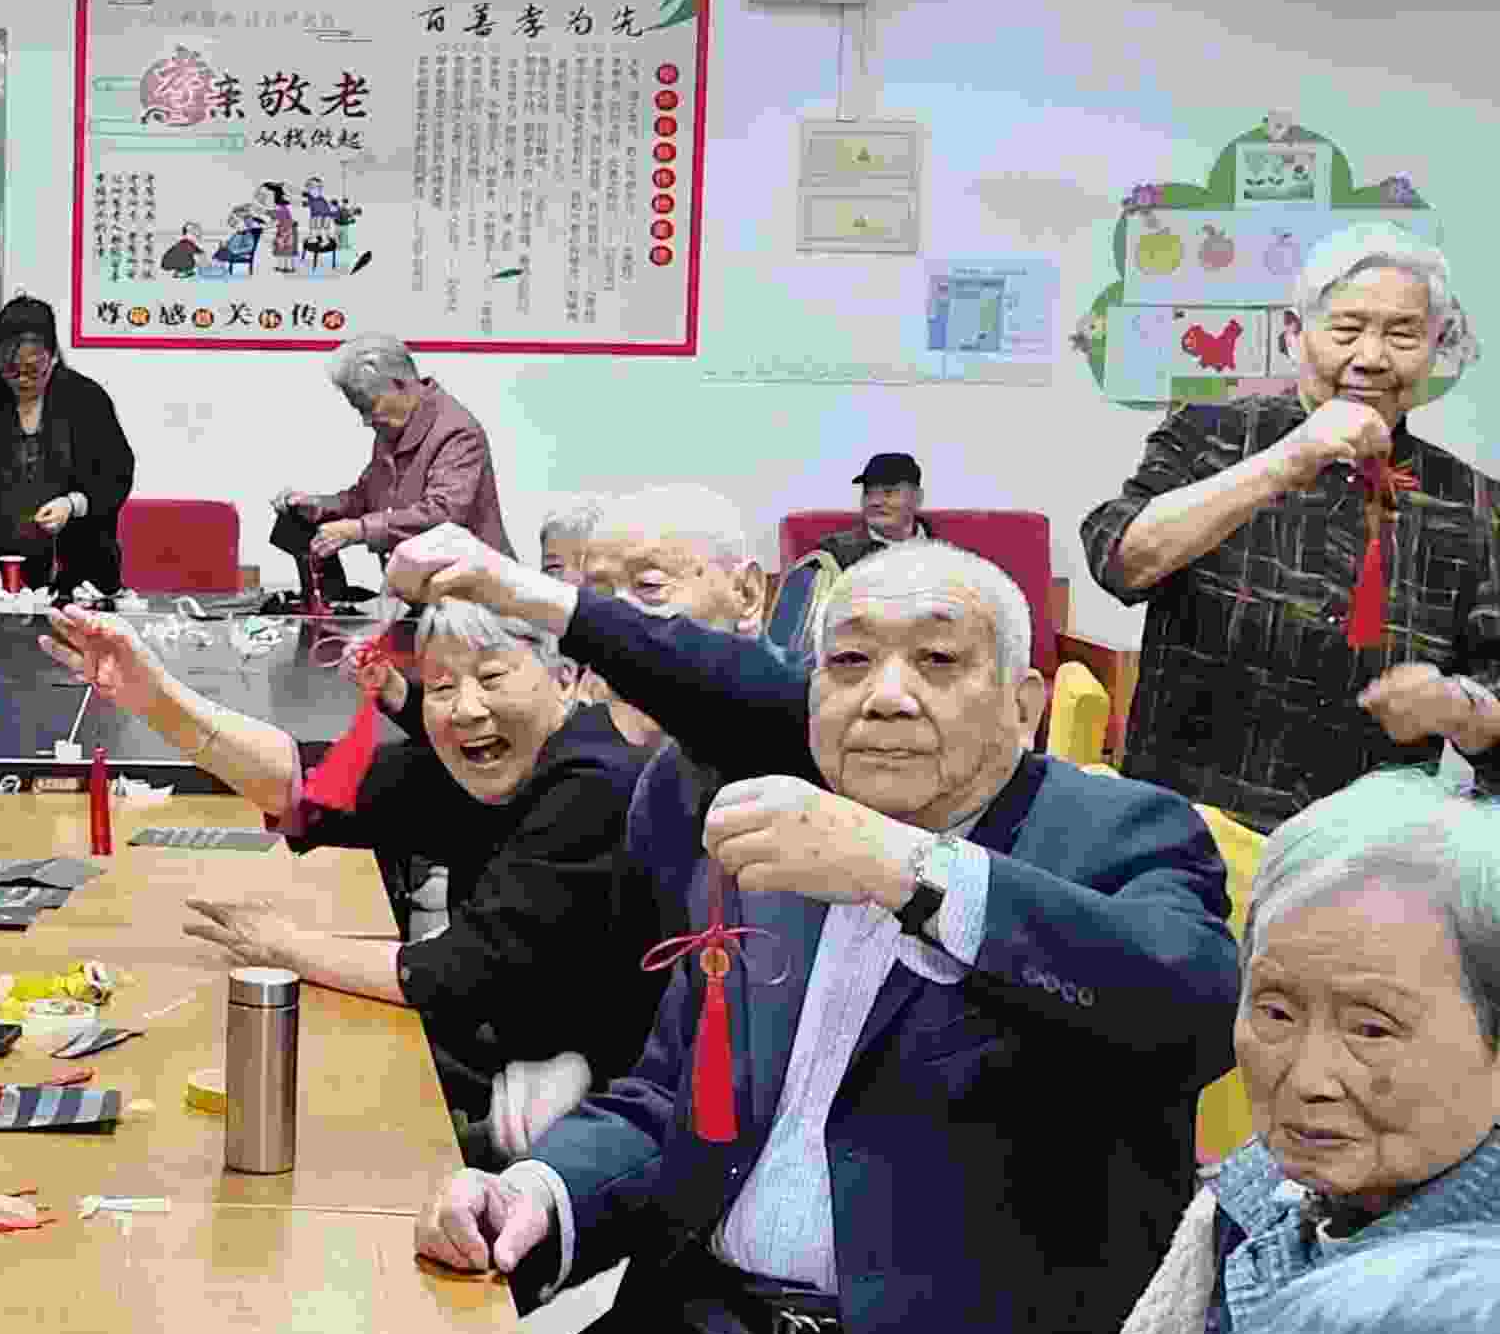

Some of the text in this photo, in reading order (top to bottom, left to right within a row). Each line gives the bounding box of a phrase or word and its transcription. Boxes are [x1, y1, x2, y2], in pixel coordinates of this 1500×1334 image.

[419, 3, 645, 38] 百善孝为先
[254, 128, 365, 151] 从我做起
